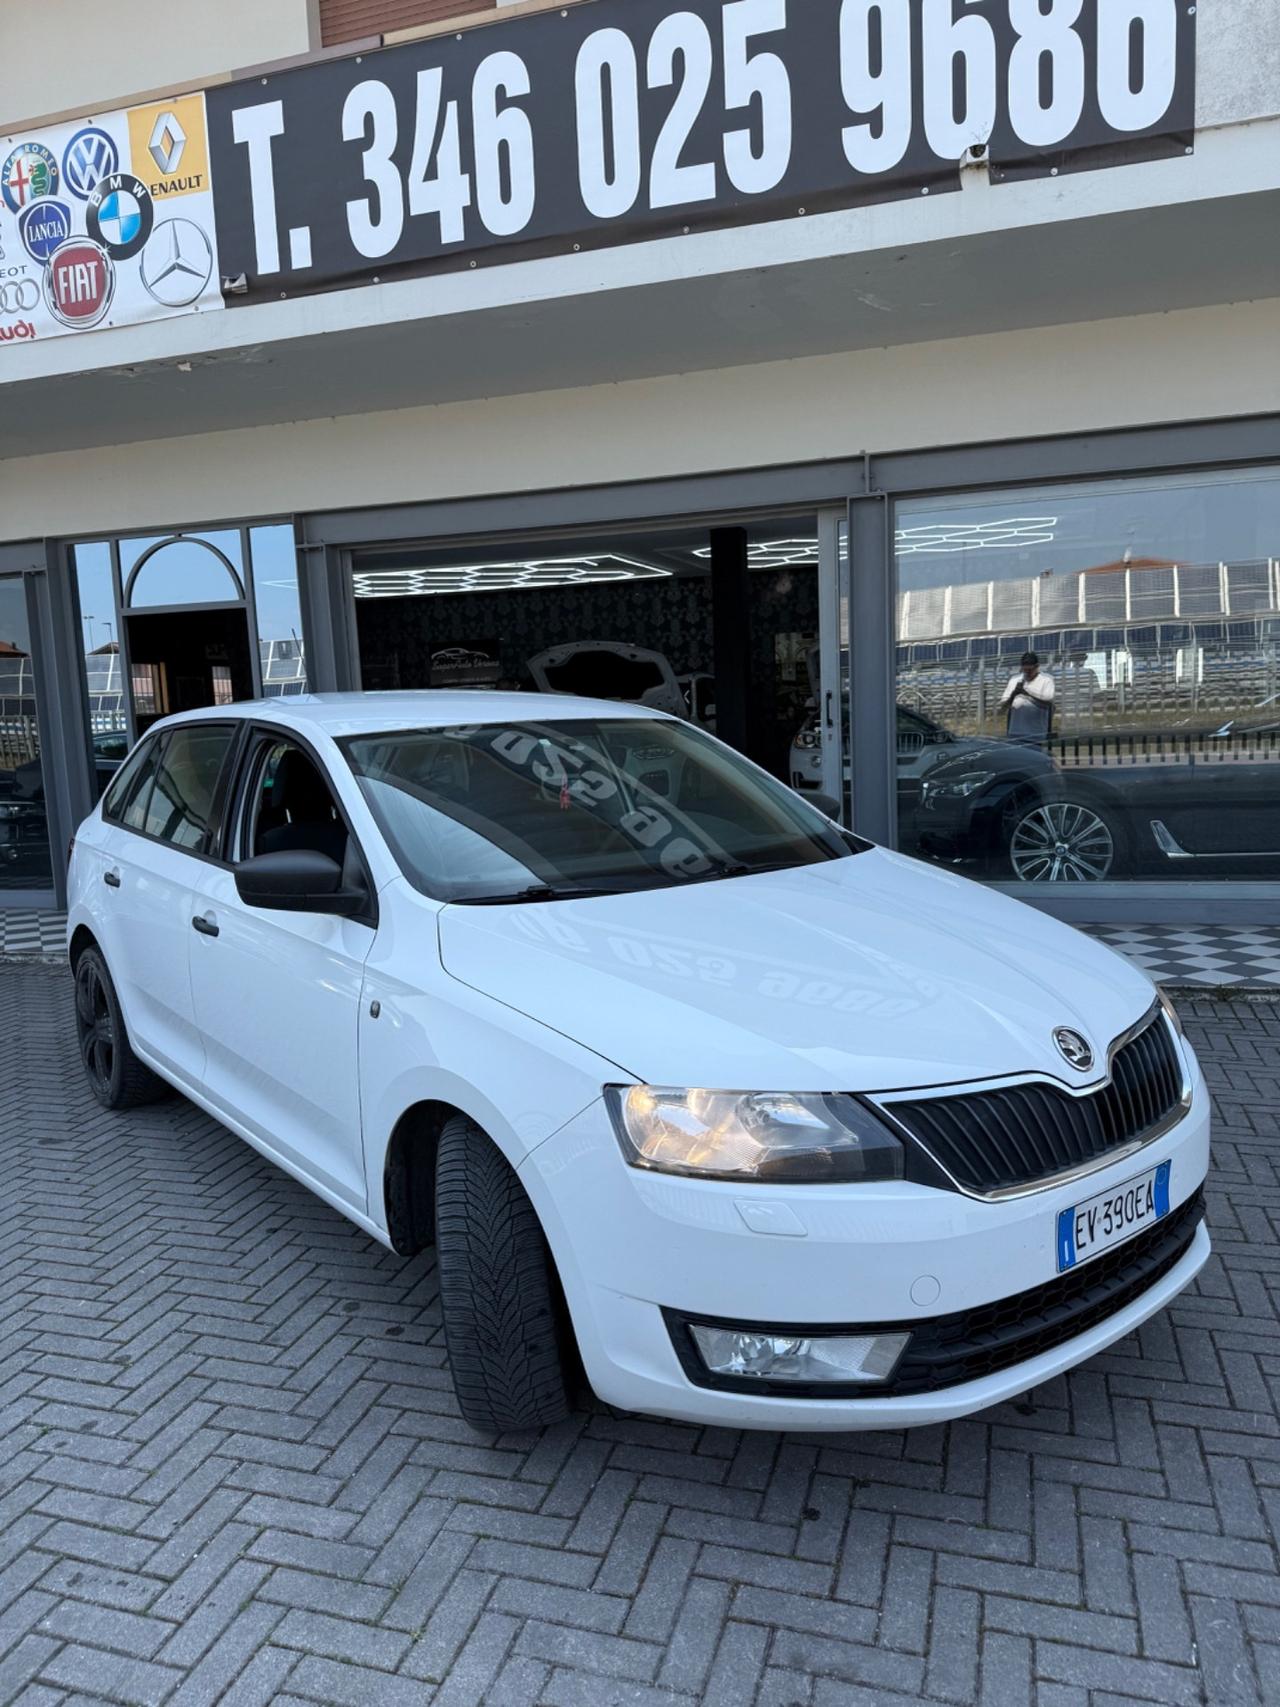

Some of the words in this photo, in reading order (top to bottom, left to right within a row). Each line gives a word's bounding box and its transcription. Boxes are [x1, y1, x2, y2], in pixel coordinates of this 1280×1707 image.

[232, 100, 312, 275] T.
[341, 50, 535, 258] 346
[575, 0, 792, 218] 025
[839, 0, 1177, 174] 9686
[91, 175, 147, 207] BMW
[148, 174, 202, 196] ENAULT
[28, 220, 64, 243] LANCIA
[58, 261, 99, 304] FIAT
[0, 319, 37, 340] udi
